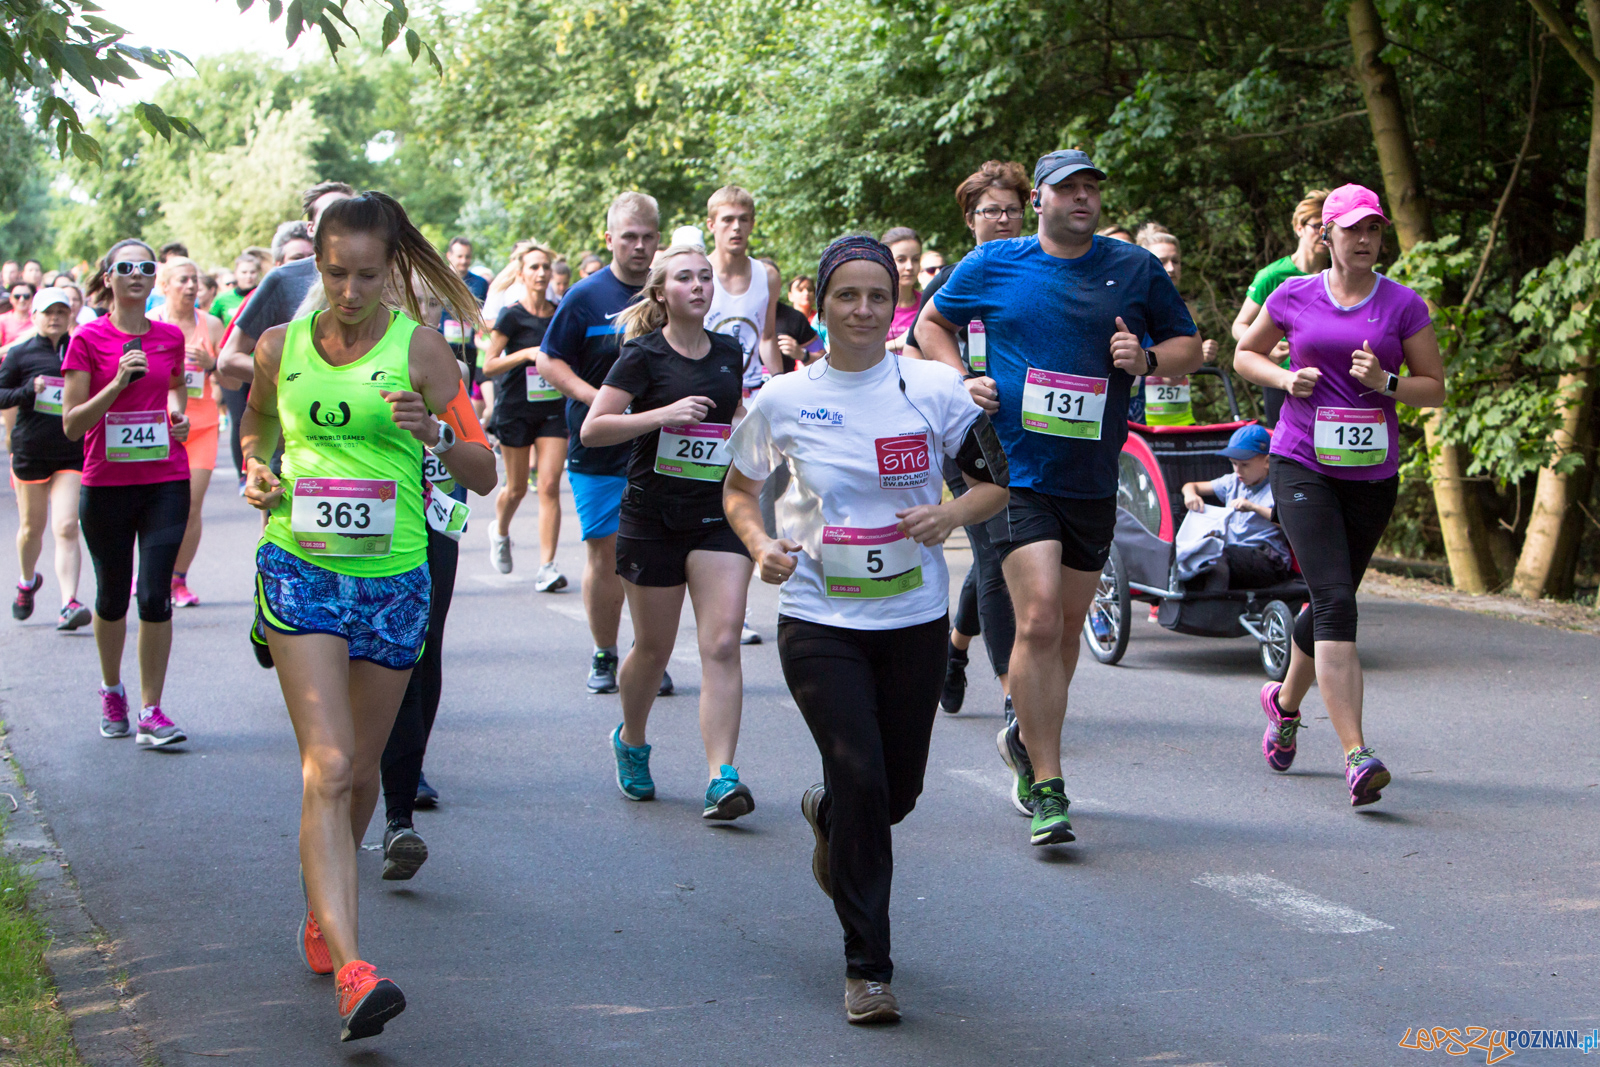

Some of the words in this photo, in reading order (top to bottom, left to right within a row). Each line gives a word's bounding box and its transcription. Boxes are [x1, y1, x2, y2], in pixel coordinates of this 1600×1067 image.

[1044, 391, 1084, 416] 131
[1157, 387, 1181, 400] 257
[800, 409, 816, 420] Pro
[827, 411, 844, 421] Life
[121, 426, 156, 444] 244
[1335, 425, 1373, 446] 132
[676, 439, 718, 460] 267
[883, 450, 927, 471] sne
[316, 501, 371, 529] 363
[866, 549, 884, 574] 5
[831, 585, 860, 593] 22.06.2018
